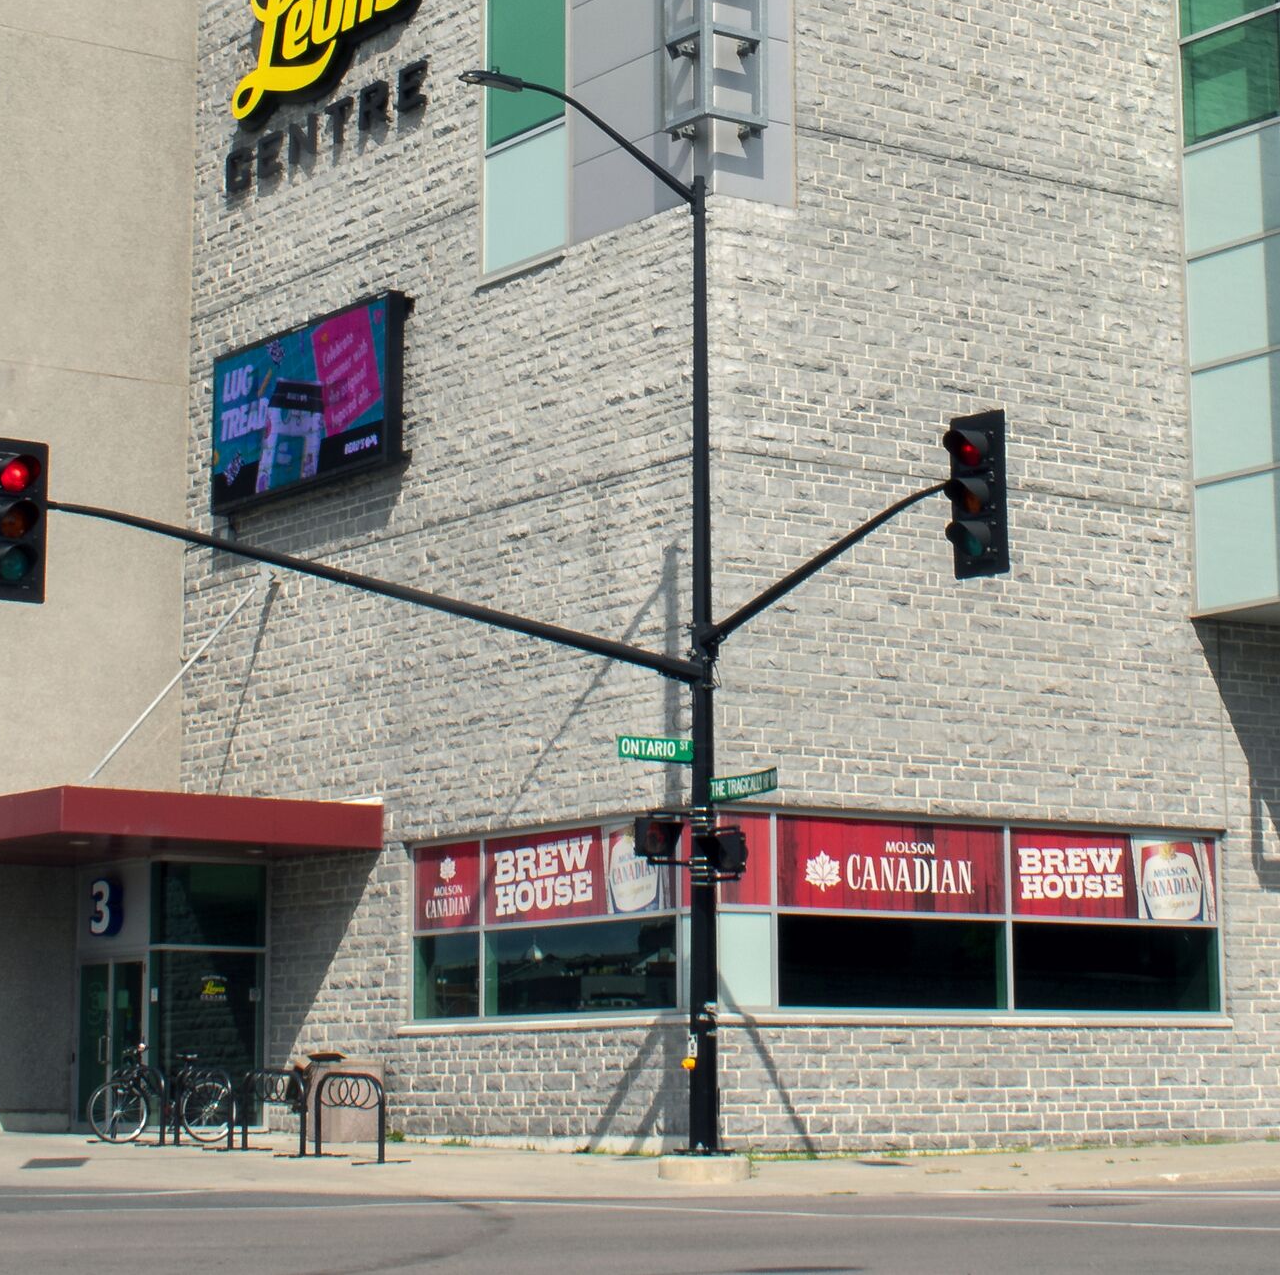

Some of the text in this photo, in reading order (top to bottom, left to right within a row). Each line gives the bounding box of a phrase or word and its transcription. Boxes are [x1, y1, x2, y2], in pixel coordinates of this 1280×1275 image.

[225, 59, 429, 193] CENTRE
[222, 364, 254, 403] LUG
[220, 397, 270, 442] TREAD
[621, 738, 689, 757] ONTARIO ST
[710, 780, 726, 797] THE
[727, 774, 762, 795] TRAGICALLY
[494, 836, 593, 885] BREW
[885, 841, 935, 855] MOLSON
[1018, 847, 1123, 874] BREW
[846, 853, 972, 894] CANADIAN
[1153, 866, 1189, 877] MOLSON
[433, 884, 463, 897] MOLSON
[495, 871, 593, 917] HOUSE
[1020, 874, 1125, 900] HOUSE
[1146, 876, 1201, 898] CANADIAN
[90, 878, 118, 936] 3
[425, 896, 471, 919] CANADIAN
